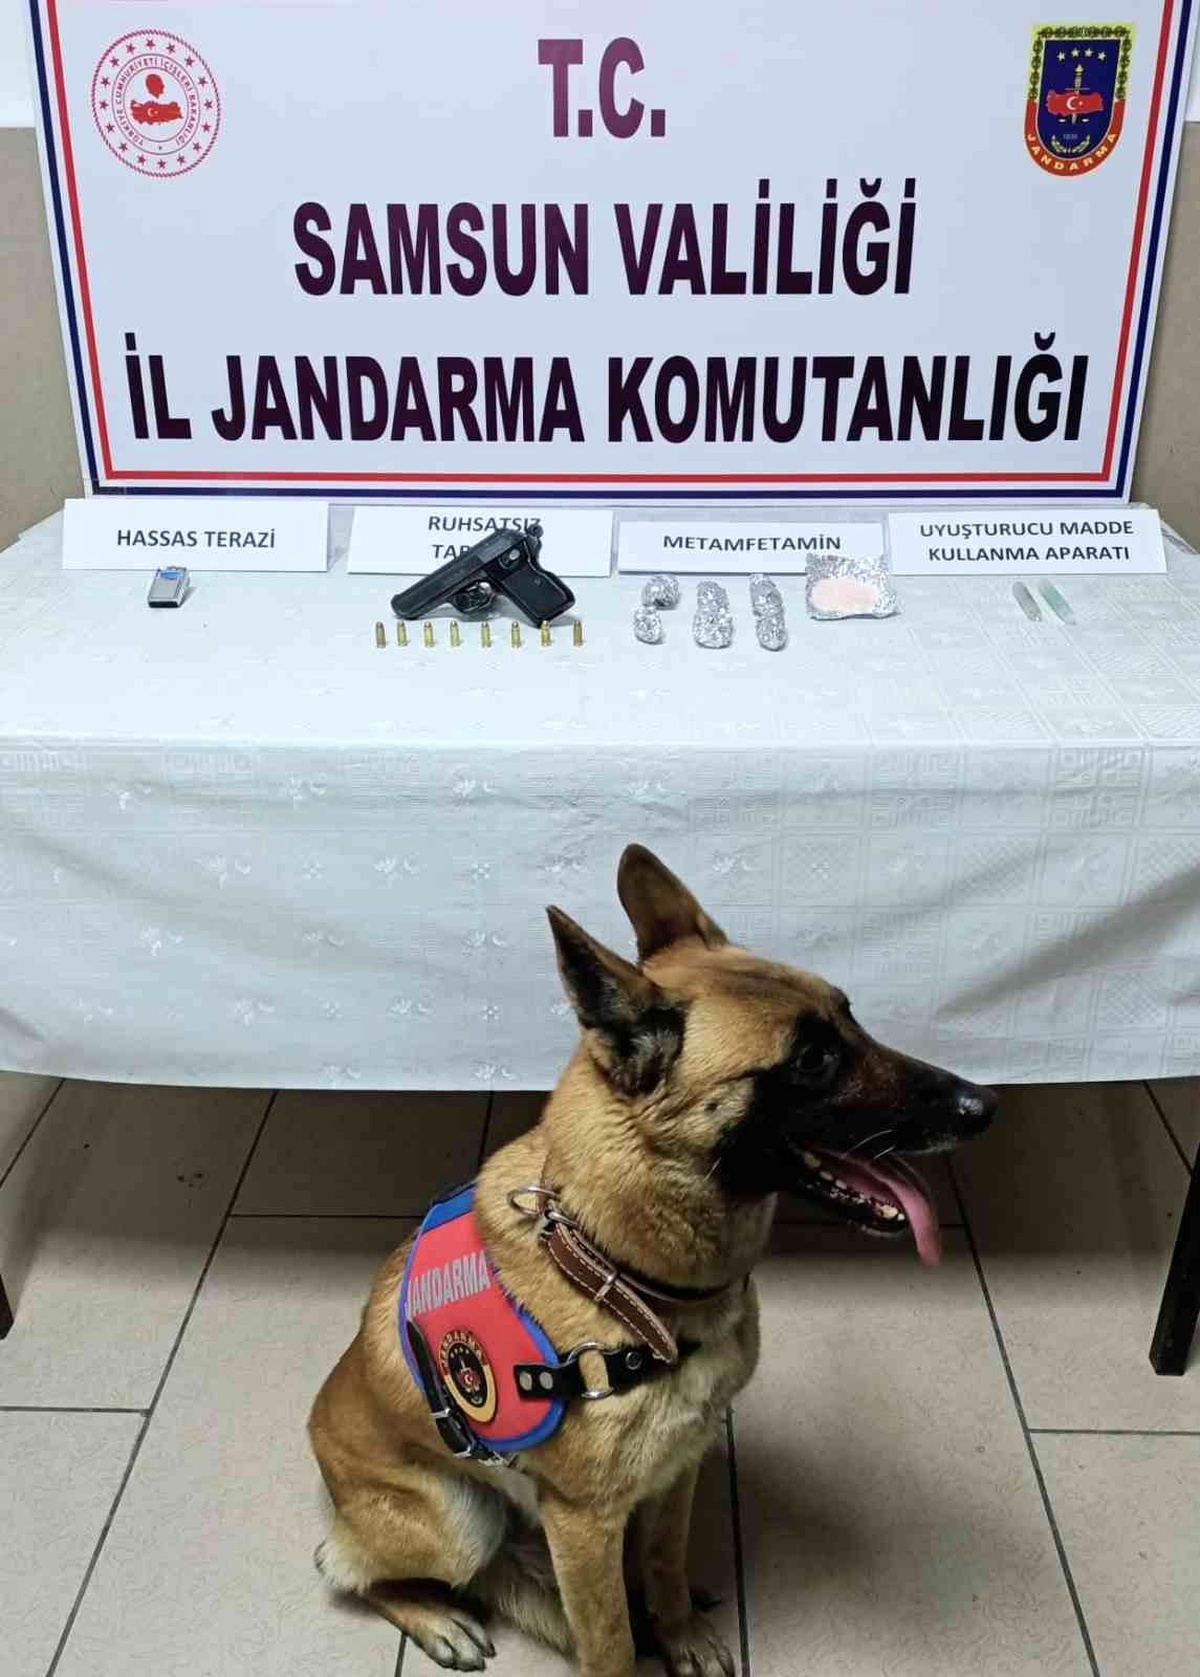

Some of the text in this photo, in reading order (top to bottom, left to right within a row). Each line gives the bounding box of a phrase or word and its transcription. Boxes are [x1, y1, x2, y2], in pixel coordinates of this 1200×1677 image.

[538, 37, 665, 138] T.C.
[1027, 133, 1117, 171] JANDARMA
[294, 178, 916, 296] SAMSUN VALİLİĞİ
[125, 332, 1089, 443] İL JANDARMA KOMUTANLIĞI
[117, 529, 275, 548] HASSAS TERAZİ
[663, 534, 841, 551] METAMFETAMİN
[920, 521, 1134, 540] UYUŞTURUCU MADDE
[929, 546, 1130, 562] KULLANMA APARATI
